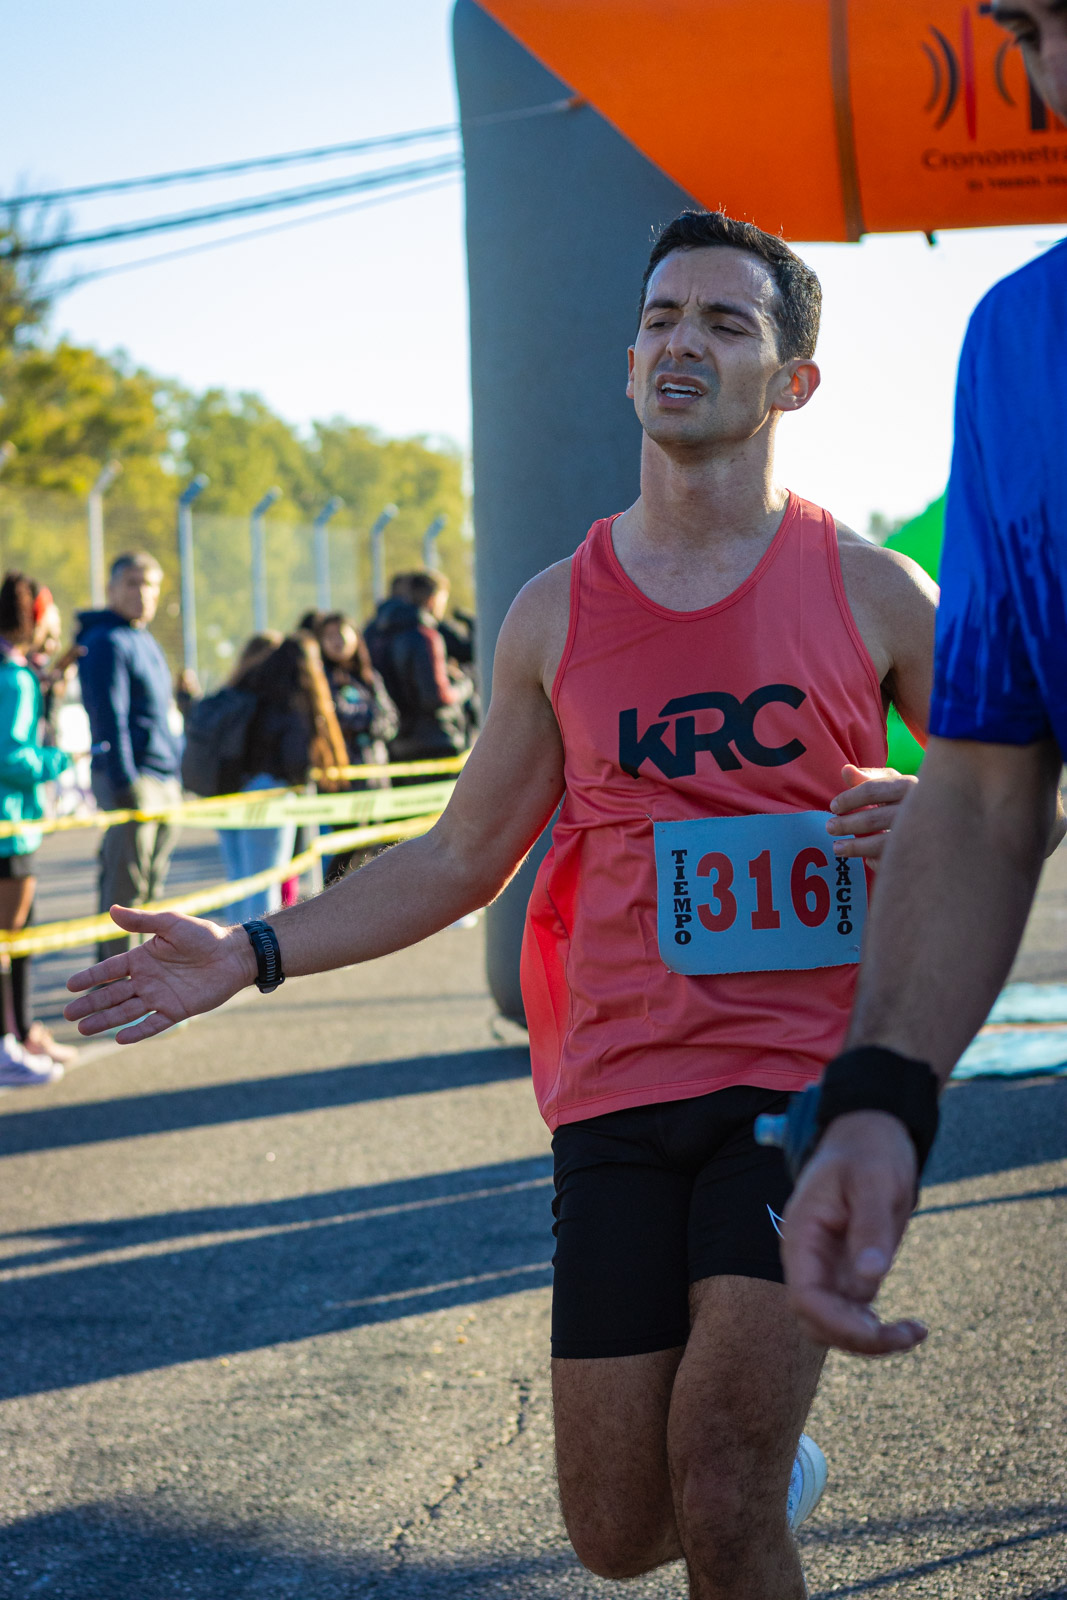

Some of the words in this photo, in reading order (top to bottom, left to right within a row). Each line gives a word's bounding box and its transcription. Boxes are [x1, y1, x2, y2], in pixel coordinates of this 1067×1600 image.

[921, 146, 1067, 171] Cronometr
[619, 684, 807, 779] KRC
[671, 849, 692, 945] TIEMPO
[696, 846, 831, 933] 316
[834, 841, 853, 935] XACTO
